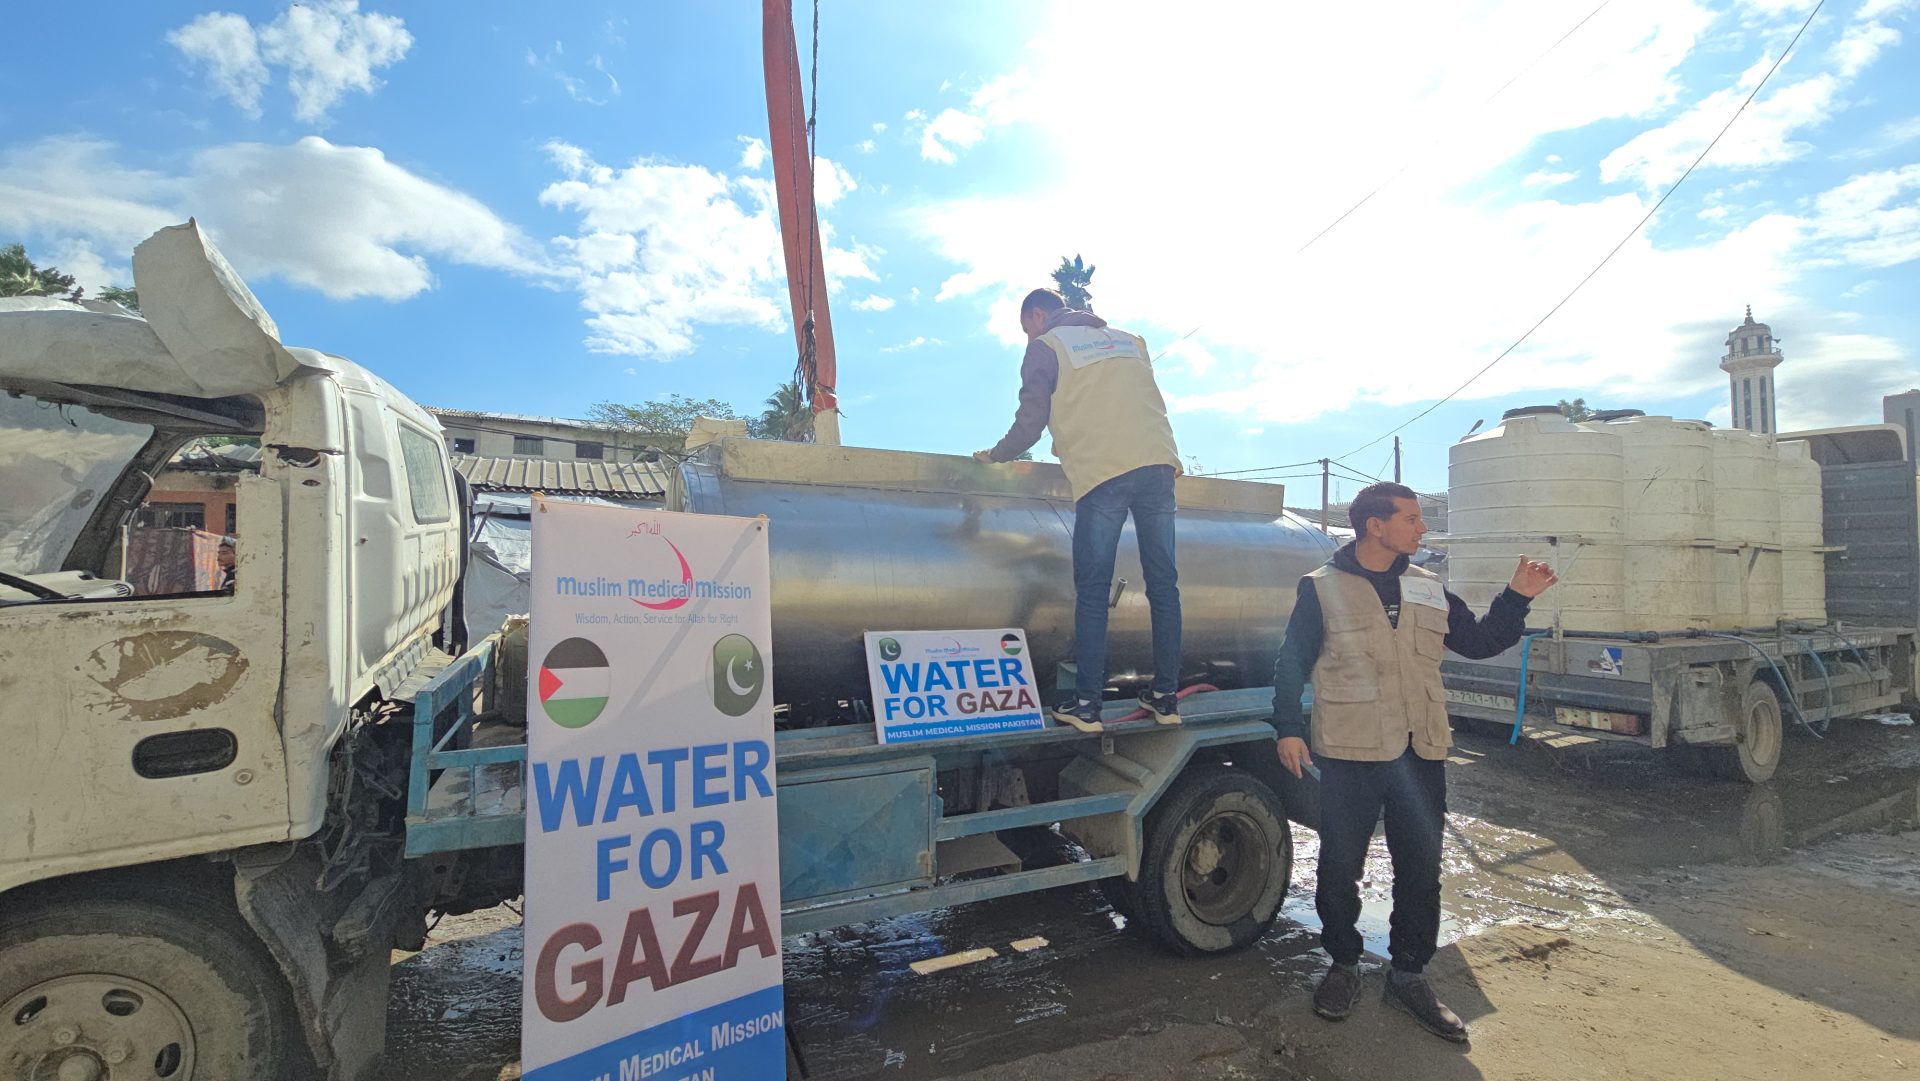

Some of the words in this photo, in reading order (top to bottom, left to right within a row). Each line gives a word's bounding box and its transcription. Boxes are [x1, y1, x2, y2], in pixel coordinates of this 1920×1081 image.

[575, 613, 611, 625] Wisdom,
[643, 613, 673, 625] Service
[687, 613, 706, 624] Allah
[880, 658, 1028, 695] WATER
[884, 694, 949, 721] FOR
[956, 688, 1036, 714] GAZA
[887, 729, 924, 739] MUSLIM
[925, 726, 965, 736] MEDICAL
[966, 722, 1001, 732] MISSION
[1002, 718, 1041, 729] PAKISTAN
[532, 739, 774, 833] WATER
[596, 820, 729, 902] FOR
[534, 881, 777, 1023] GAZA
